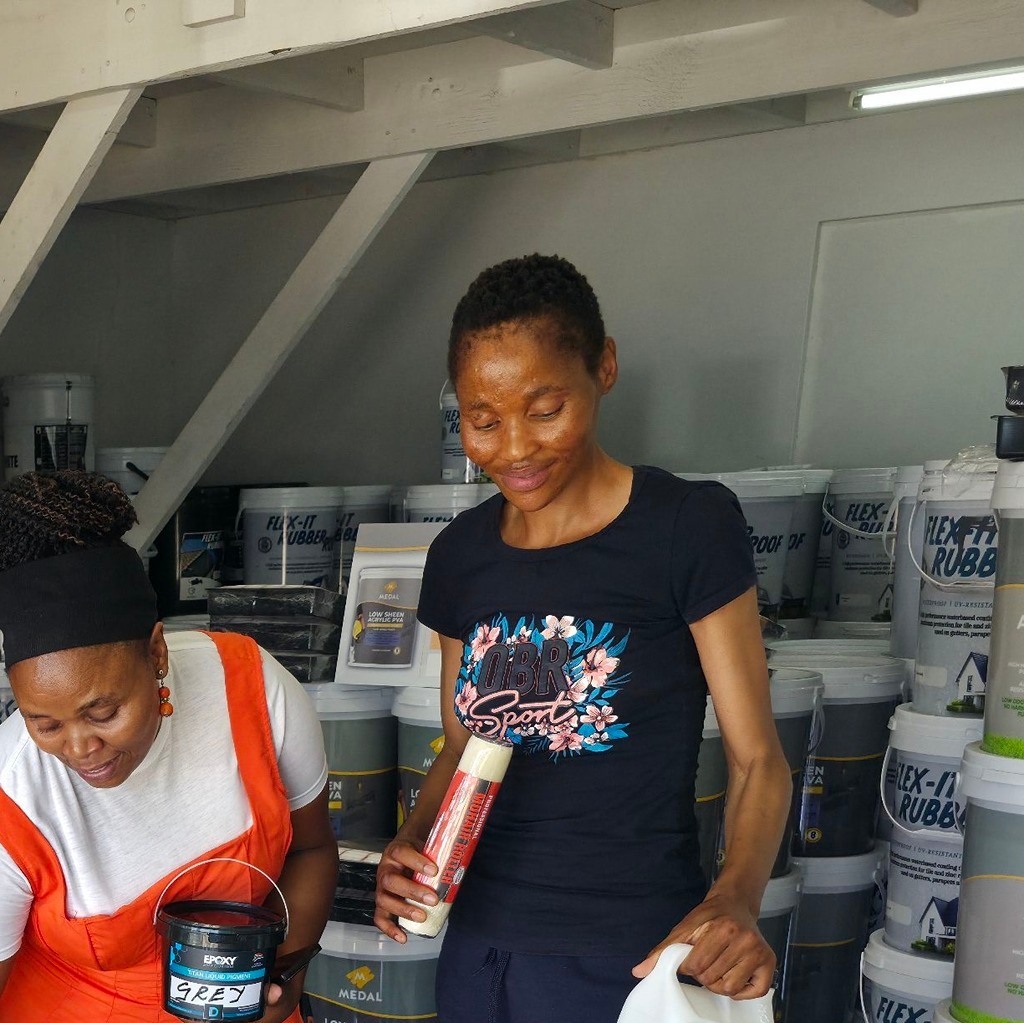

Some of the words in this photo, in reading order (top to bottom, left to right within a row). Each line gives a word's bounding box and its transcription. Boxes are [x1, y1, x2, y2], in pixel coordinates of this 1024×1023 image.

[266, 514, 318, 530] FLEX-IT
[931, 547, 998, 578] RUBB
[477, 639, 570, 697] OBR
[469, 689, 576, 740] Sport
[472, 795, 494, 840] PROFESSIONAL
[900, 794, 966, 830] RUBB
[203, 954, 237, 965] EPOXY
[187, 968, 204, 978] TITAN
[204, 972, 226, 980] LIQUID
[177, 981, 246, 1004] GREY
[338, 988, 383, 1002] MEDAL
[208, 1006, 219, 1017] D
